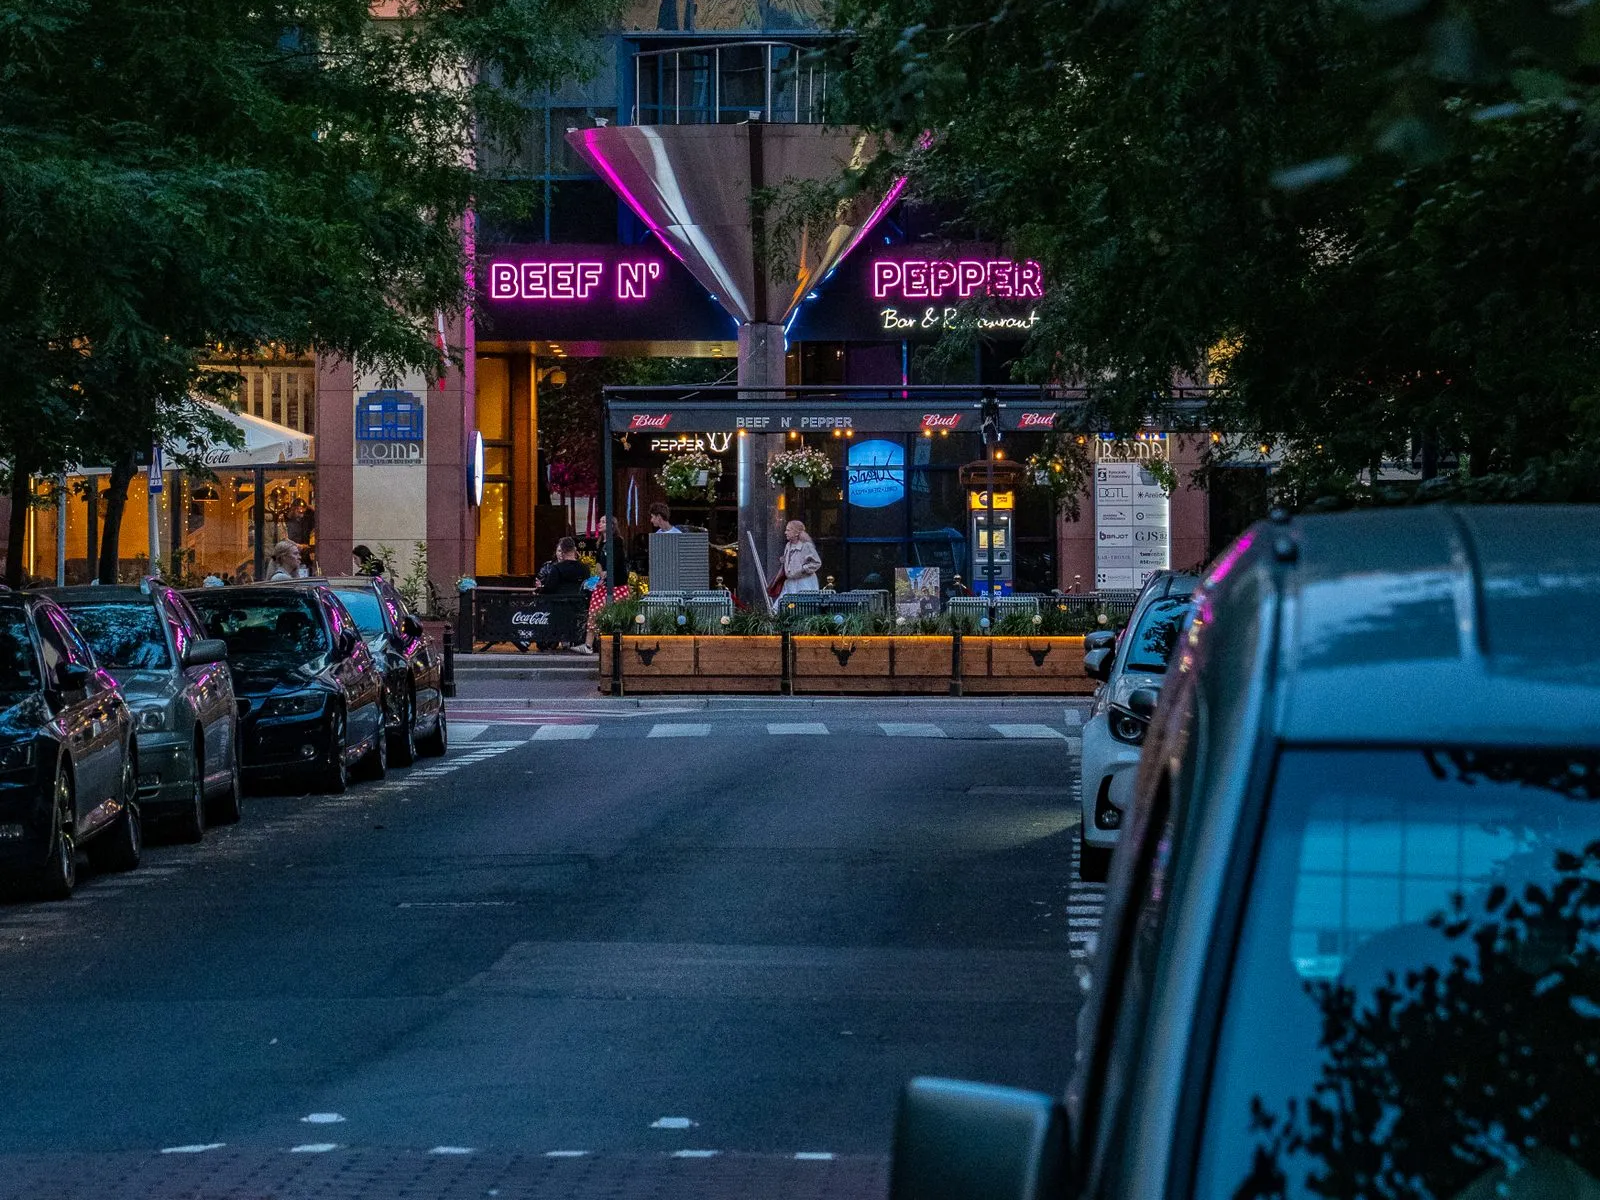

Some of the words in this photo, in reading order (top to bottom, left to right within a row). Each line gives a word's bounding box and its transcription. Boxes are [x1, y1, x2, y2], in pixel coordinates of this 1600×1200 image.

[491, 262, 603, 299] BEEF
[617, 262, 661, 299] N'
[874, 261, 1043, 297] PEPPER
[880, 308, 917, 329] Bar
[920, 306, 940, 328] &
[632, 413, 668, 427] Bud
[736, 416, 770, 428] BEEF
[800, 416, 853, 428] PEPPER
[922, 412, 958, 426] Bud
[1021, 412, 1057, 425] Bud
[360, 443, 420, 459] ROMA
[651, 439, 705, 452] PEPPER
